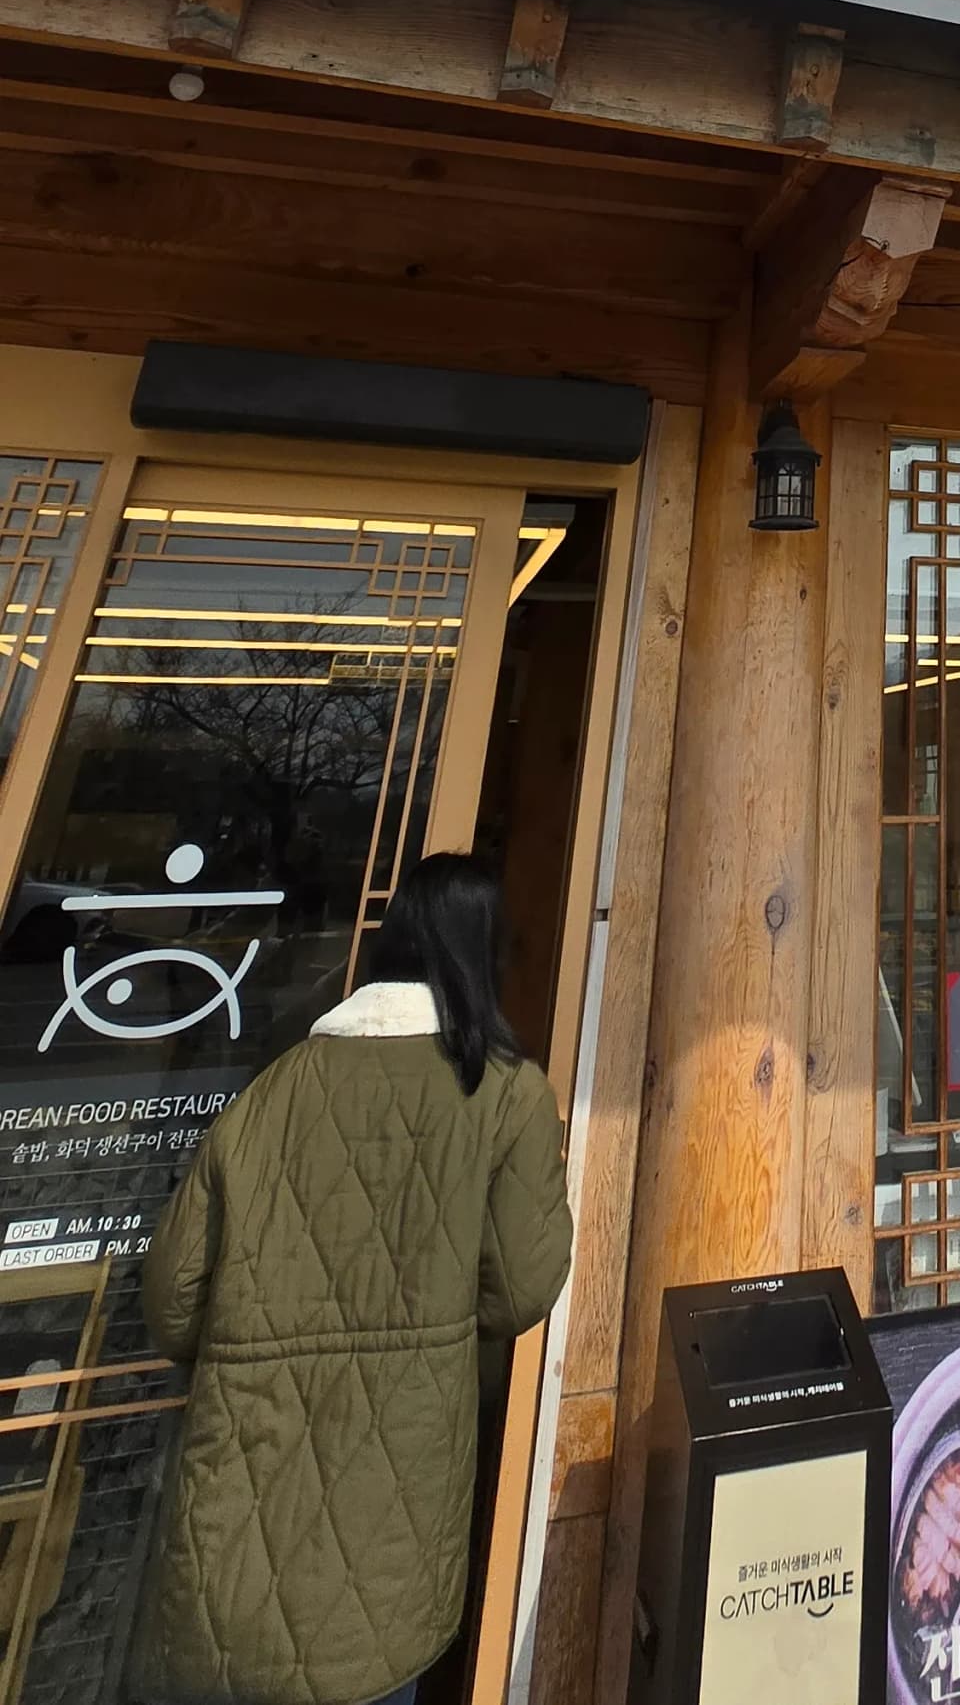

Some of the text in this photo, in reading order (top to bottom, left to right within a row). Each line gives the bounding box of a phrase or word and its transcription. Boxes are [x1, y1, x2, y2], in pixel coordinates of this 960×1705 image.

[0, 1106, 63, 1132] REAN
[64, 1100, 127, 1126] FOOD
[11, 1142, 50, 1164] 솥밥,
[55, 1138, 91, 1160] 화덕
[95, 1131, 163, 1157] 생선구이
[12, 1222, 51, 1240] OPEN
[65, 1218, 93, 1235] AM.
[4, 1250, 41, 1266] LAST
[44, 1244, 94, 1262] ORDER
[104, 1240, 132, 1257] PM.
[731, 1279, 784, 1293] CATCHTABLE
[738, 1546, 843, 1583] 즐거운 미식생활의 시작
[720, 1570, 854, 1619] CATCHTABLE
